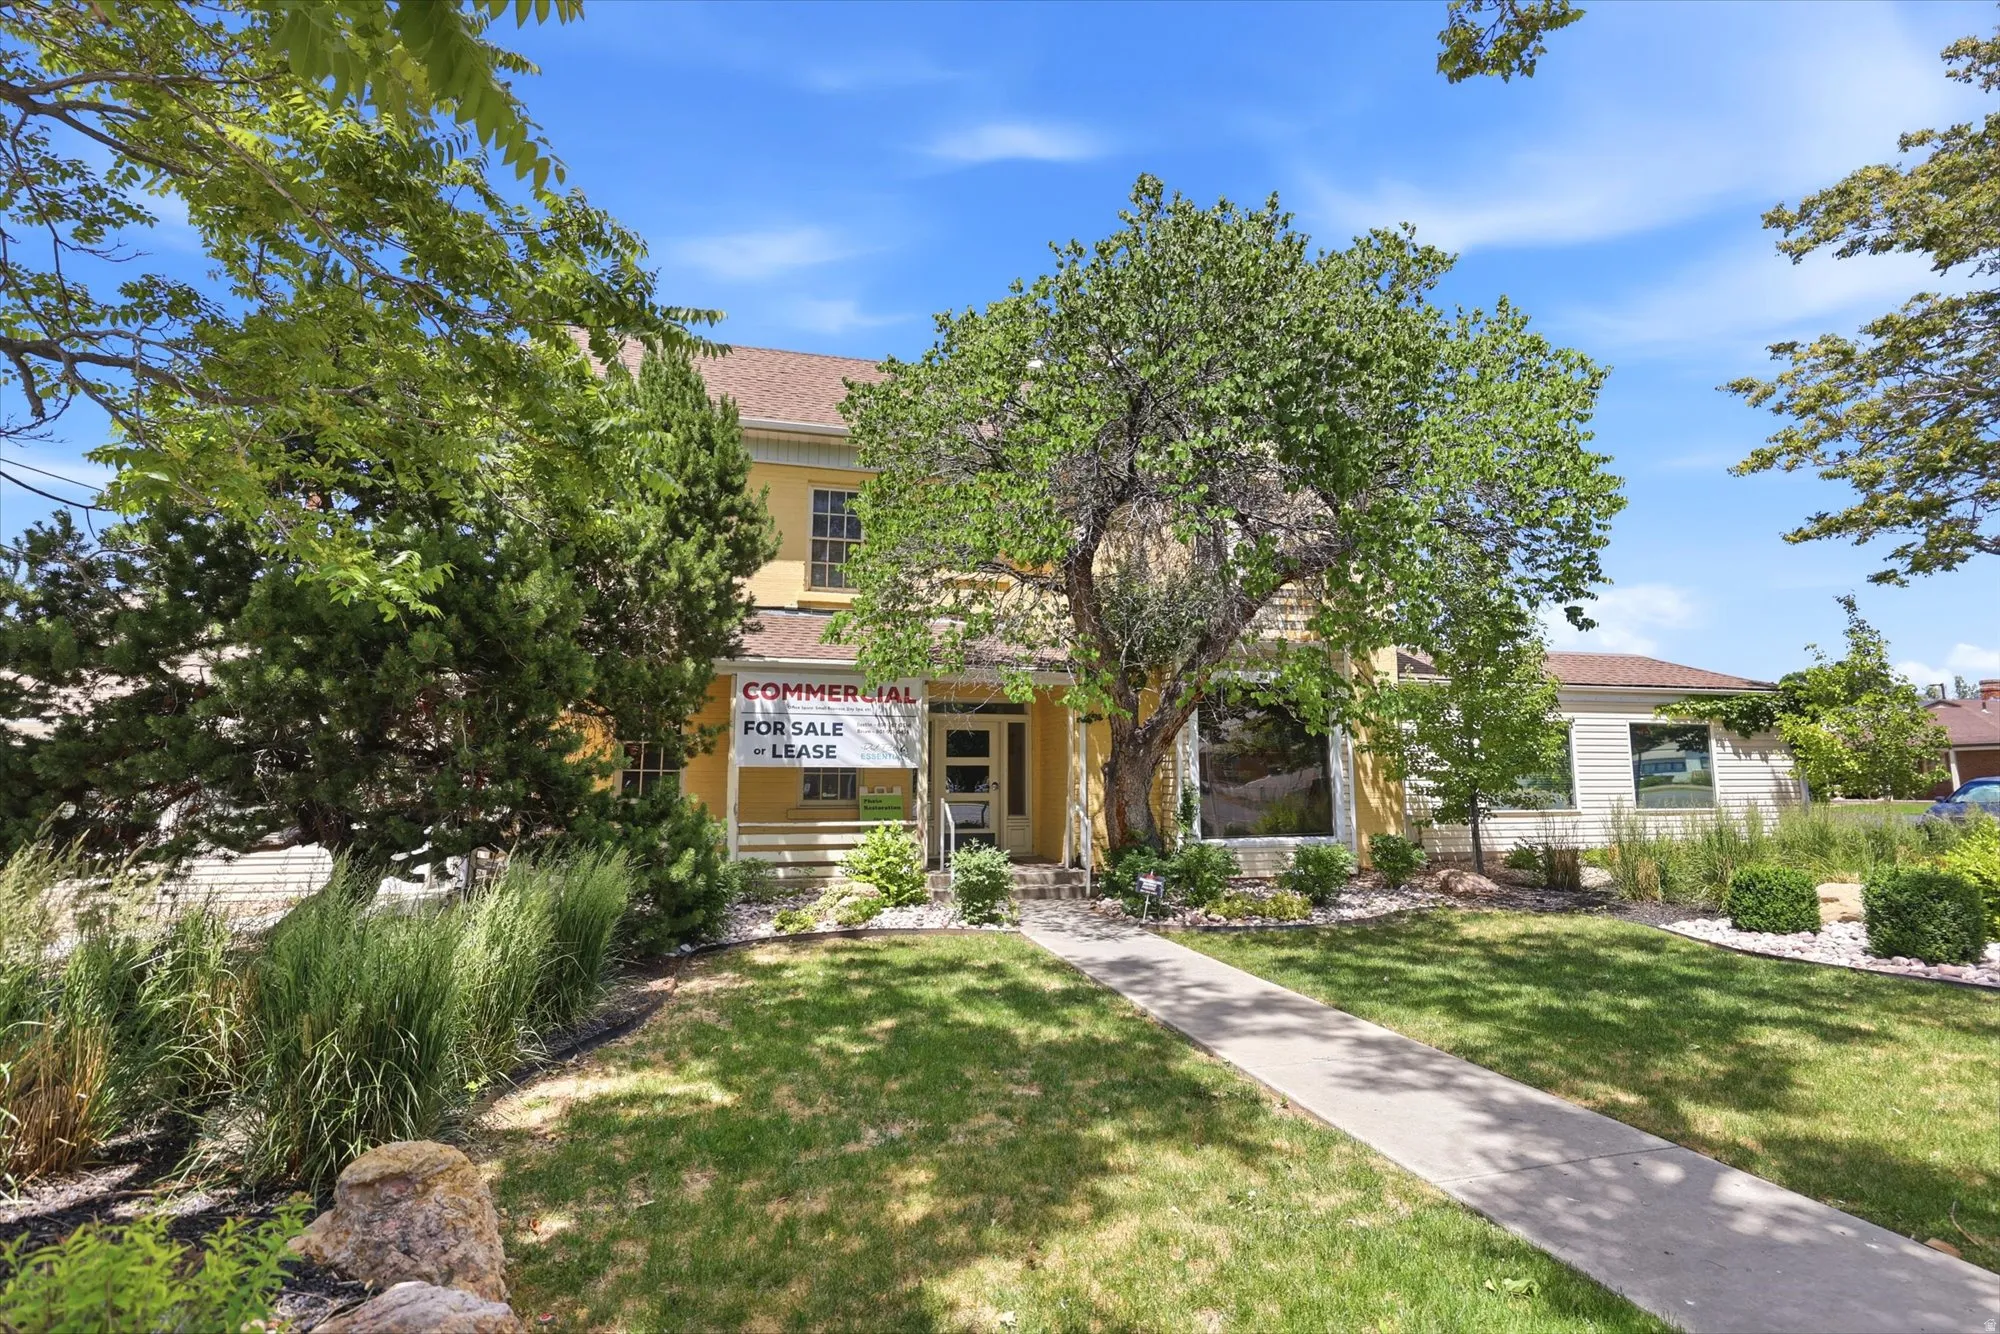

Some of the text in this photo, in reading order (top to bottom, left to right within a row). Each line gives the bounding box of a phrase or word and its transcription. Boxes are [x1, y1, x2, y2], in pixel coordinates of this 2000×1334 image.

[743, 720, 786, 736] FOR
[791, 721, 844, 737] SALE
[753, 743, 837, 759] or LEASE
